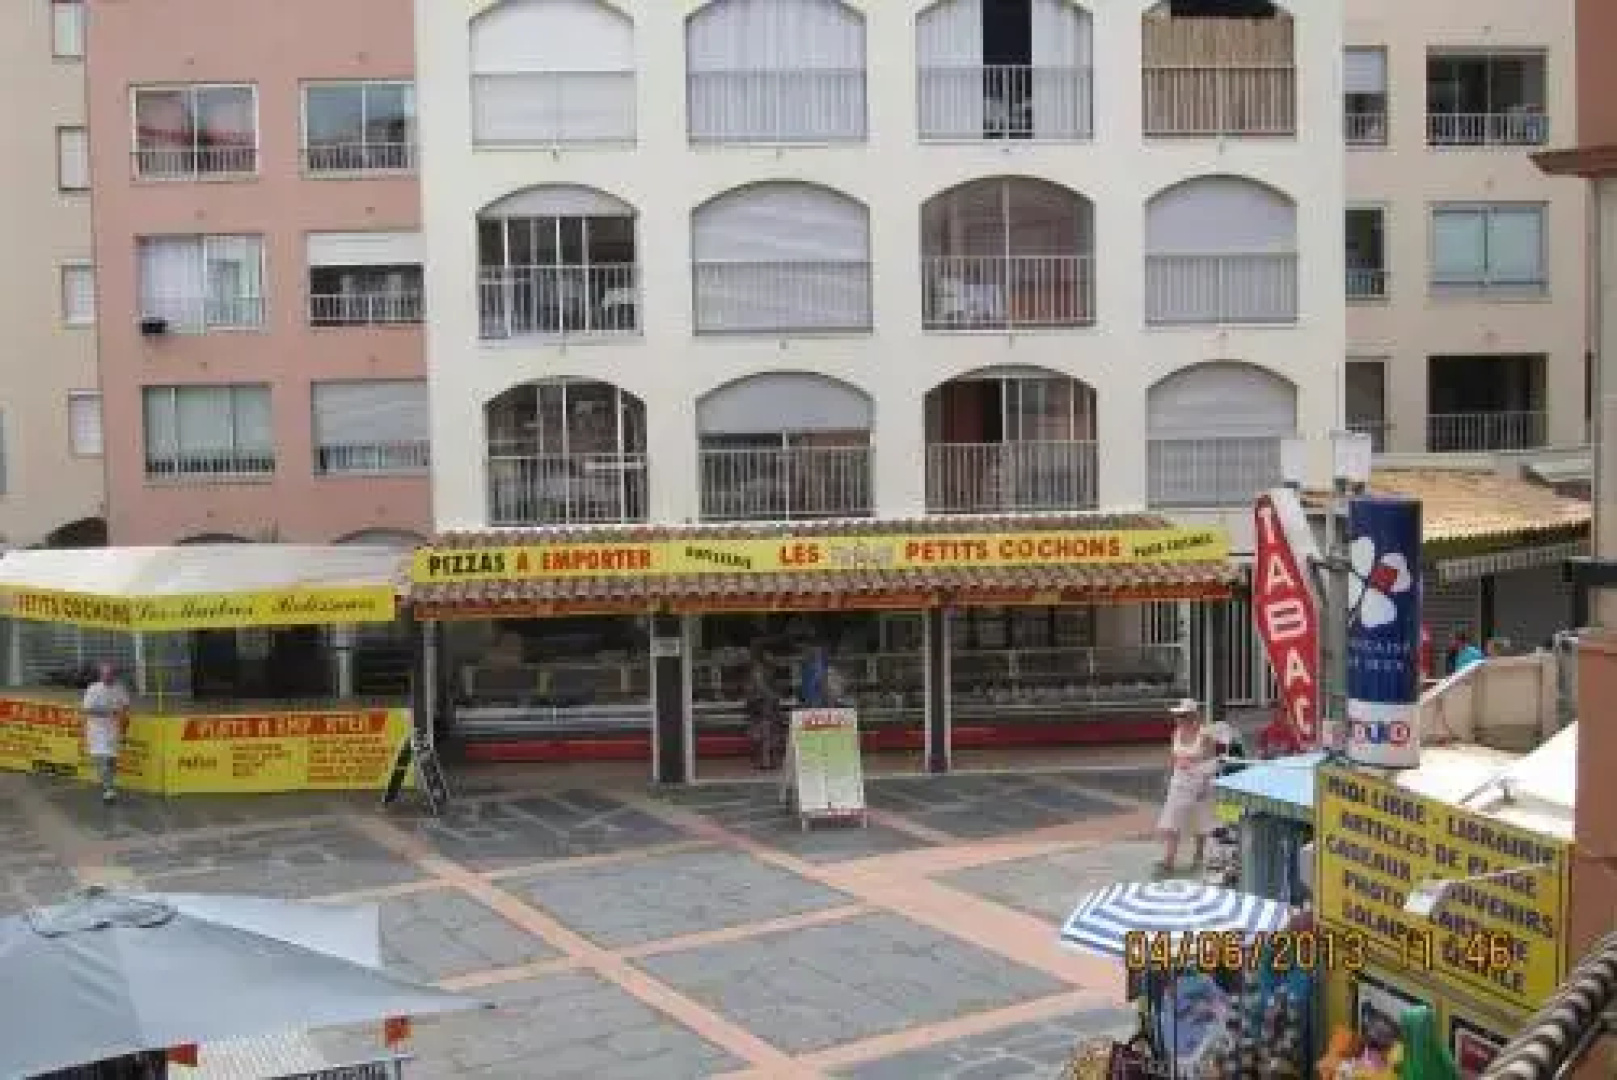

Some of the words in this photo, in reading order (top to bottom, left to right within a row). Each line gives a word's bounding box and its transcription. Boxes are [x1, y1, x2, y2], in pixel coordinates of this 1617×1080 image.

[428, 552, 506, 577] PIZZAS
[542, 548, 652, 571] EMPORTER
[779, 544, 820, 565] LES
[904, 540, 989, 562] PETITS
[998, 536, 1121, 561] COCHONS
[1257, 505, 1312, 737] TABAC
[1326, 773, 1366, 804] MIDI
[1374, 792, 1426, 825] LIBRE
[1325, 835, 1412, 881] CADEAUX
[1340, 810, 1427, 858] ARTICLES
[1434, 842, 1458, 869] DE
